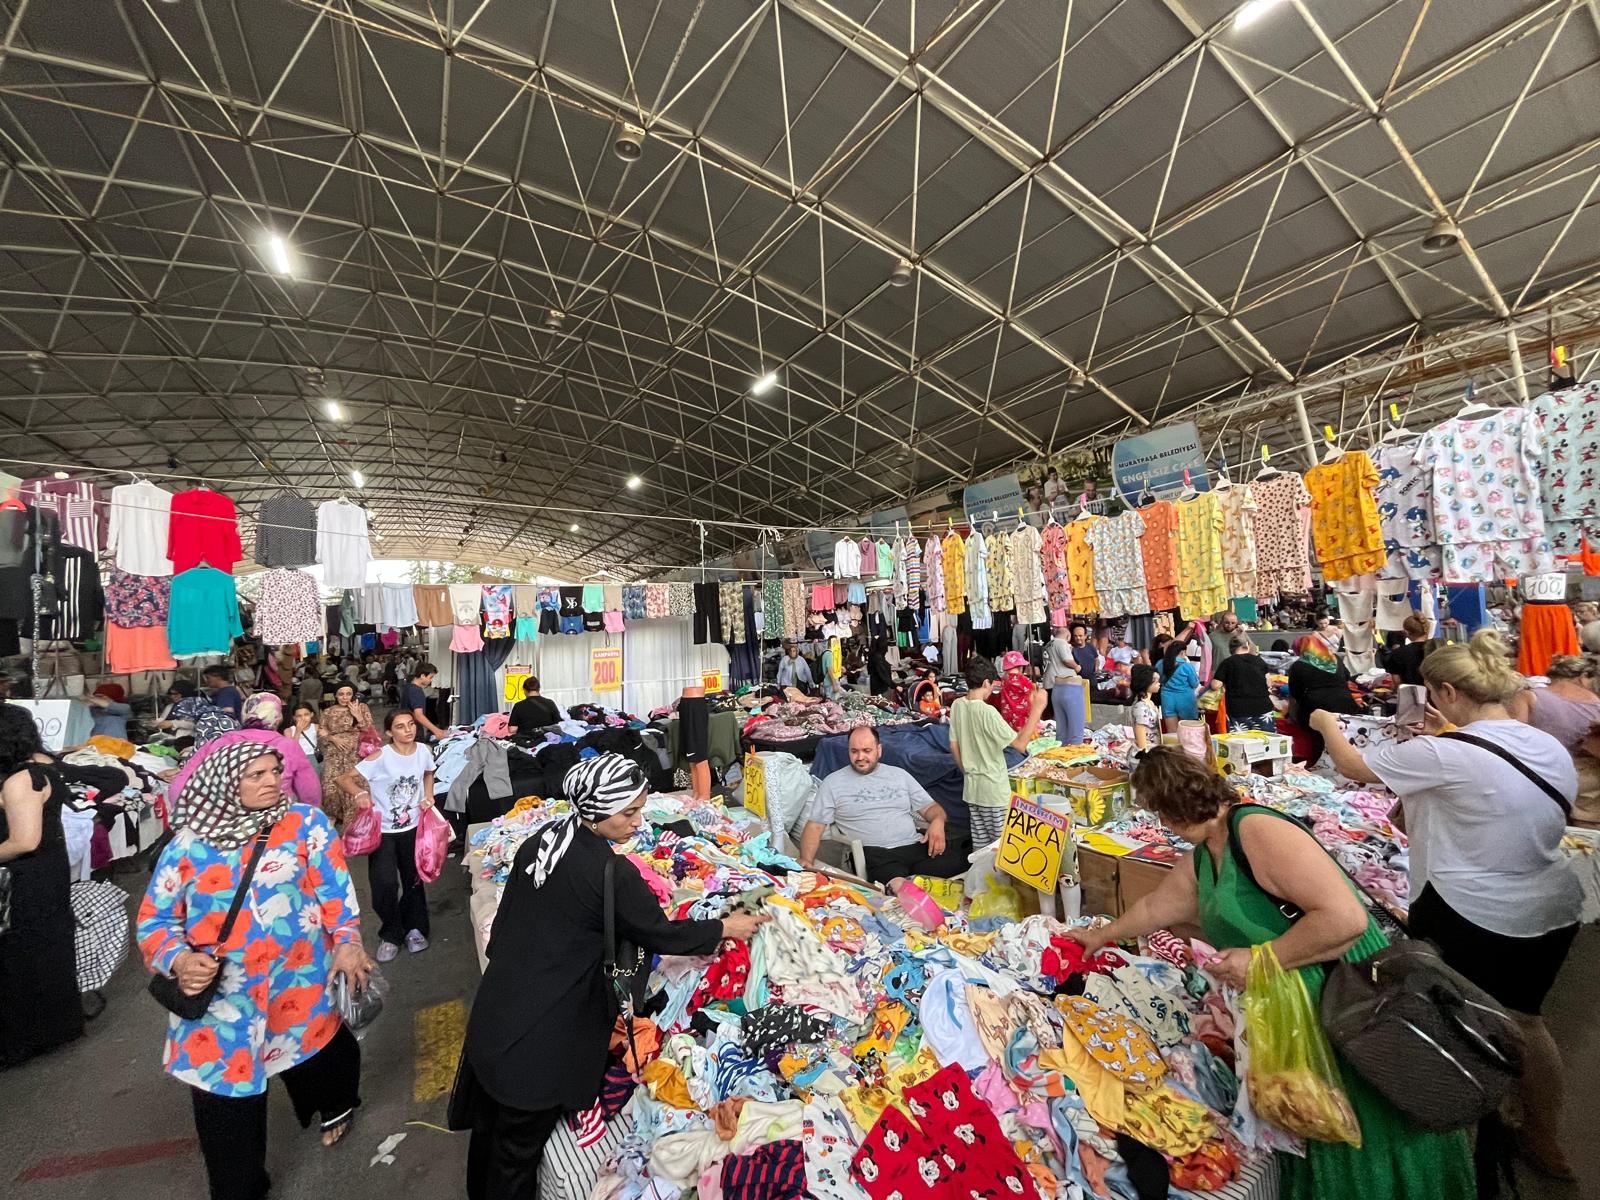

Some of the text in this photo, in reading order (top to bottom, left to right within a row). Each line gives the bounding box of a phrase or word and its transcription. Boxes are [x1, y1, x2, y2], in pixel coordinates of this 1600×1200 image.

[594, 661, 616, 685] 200
[703, 676, 718, 689] 100
[1002, 832, 1049, 877] 50
